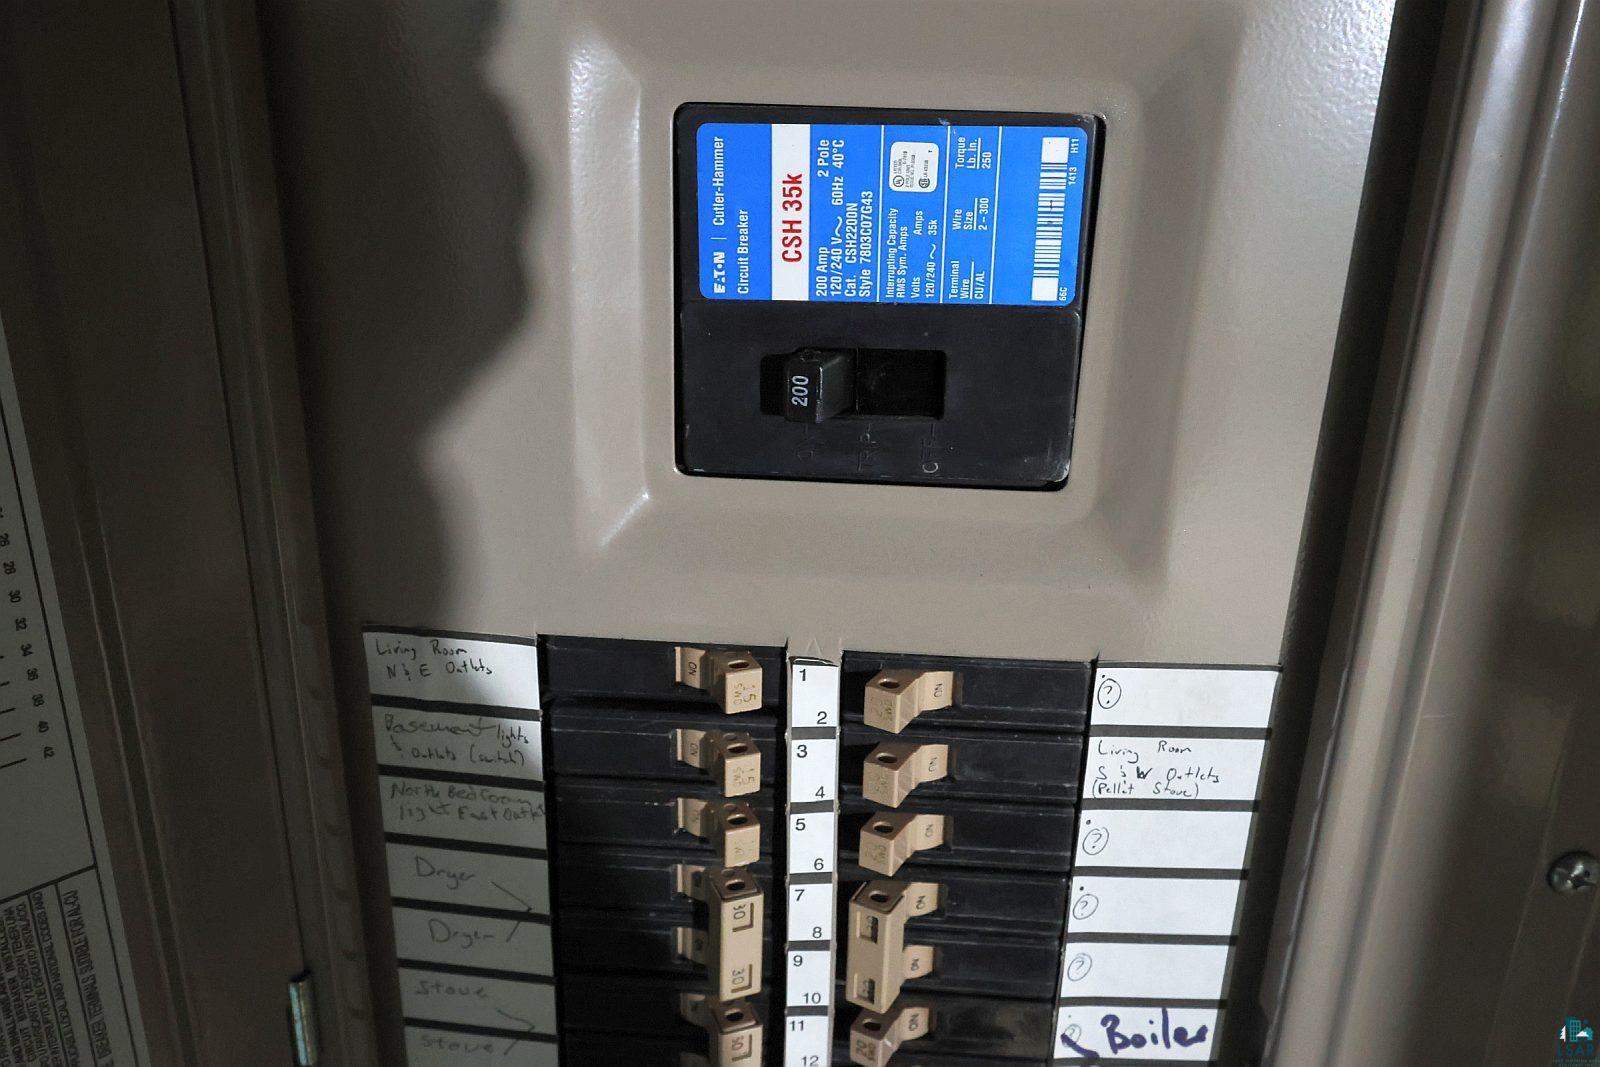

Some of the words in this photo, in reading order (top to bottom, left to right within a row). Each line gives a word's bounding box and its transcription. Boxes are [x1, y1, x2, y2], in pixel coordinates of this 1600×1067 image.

[817, 140, 830, 168] Pole
[832, 140, 844, 168] 40°C
[955, 137, 967, 168] Torque
[968, 139, 976, 151] In.
[1070, 138, 1080, 154] H11
[967, 153, 976, 168] Lb.
[982, 152, 992, 169] 250
[713, 136, 725, 226] Cutler-Hammer
[817, 170, 829, 178] 2
[1069, 166, 1077, 185] 1413
[782, 174, 802, 211] 35k
[832, 176, 844, 206] 60Hz
[860, 191, 873, 264] 7803C07G43
[887, 208, 898, 246] Capacity
[913, 210, 924, 236] Amps
[928, 219, 938, 236] 35k
[952, 208, 962, 230] Wire
[964, 211, 974, 230] Size
[736, 210, 748, 253] Breaker
[782, 220, 802, 262] CSH
[845, 202, 858, 264] CSH2200N
[898, 226, 910, 252] Amps
[816, 247, 830, 272] Amp
[897, 255, 907, 275] Sym.
[737, 258, 748, 294] Circuit
[830, 250, 843, 296] 120/240
[886, 247, 897, 298] Interrupting
[925, 262, 936, 298] 120/240
[949, 261, 960, 299] Terminal
[816, 274, 828, 296] 200
[844, 275, 856, 297] Cat.
[859, 269, 872, 297] Style
[897, 276, 906, 298] RMS
[911, 277, 920, 298] Volts
[960, 279, 970, 299] Wire
[974, 271, 984, 299] CU/AL
[792, 375, 809, 406] 200
[376, 640, 416, 660] Living
[430, 639, 468, 656] Room
[387, 665, 396, 679] N
[420, 664, 431, 677] E
[446, 659, 492, 674] Outlets
[688, 661, 698, 676] ON
[799, 669, 806, 682] 1
[934, 683, 944, 698] ON
[817, 711, 828, 724] 2
[690, 742, 698, 756] ON
[796, 744, 808, 758] 3
[1098, 740, 1139, 764] Living
[1158, 740, 1192, 754] Room
[928, 756, 938, 772] ON
[1096, 766, 1108, 780] S
[1166, 766, 1220, 784] Outlets
[815, 786, 826, 798] 4
[1152, 782, 1199, 798] Stove)
[796, 818, 806, 830] 5
[925, 824, 934, 838] ON
[415, 856, 476, 890] Dryer
[814, 858, 824, 870] 6
[794, 889, 806, 902] 7
[916, 896, 925, 910] ON
[732, 904, 746, 920] 30
[428, 918, 494, 948] Dryer
[812, 926, 822, 938] 8
[793, 954, 803, 967] 9
[731, 968, 745, 985] 30
[416, 980, 488, 998] Stove
[803, 992, 822, 1004] 10
[789, 1020, 805, 1032] 11
[909, 1014, 918, 1031] ON
[1100, 1006, 1208, 1055] Boiler
[423, 1036, 494, 1054] Stove
[802, 1056, 820, 1067] 12
